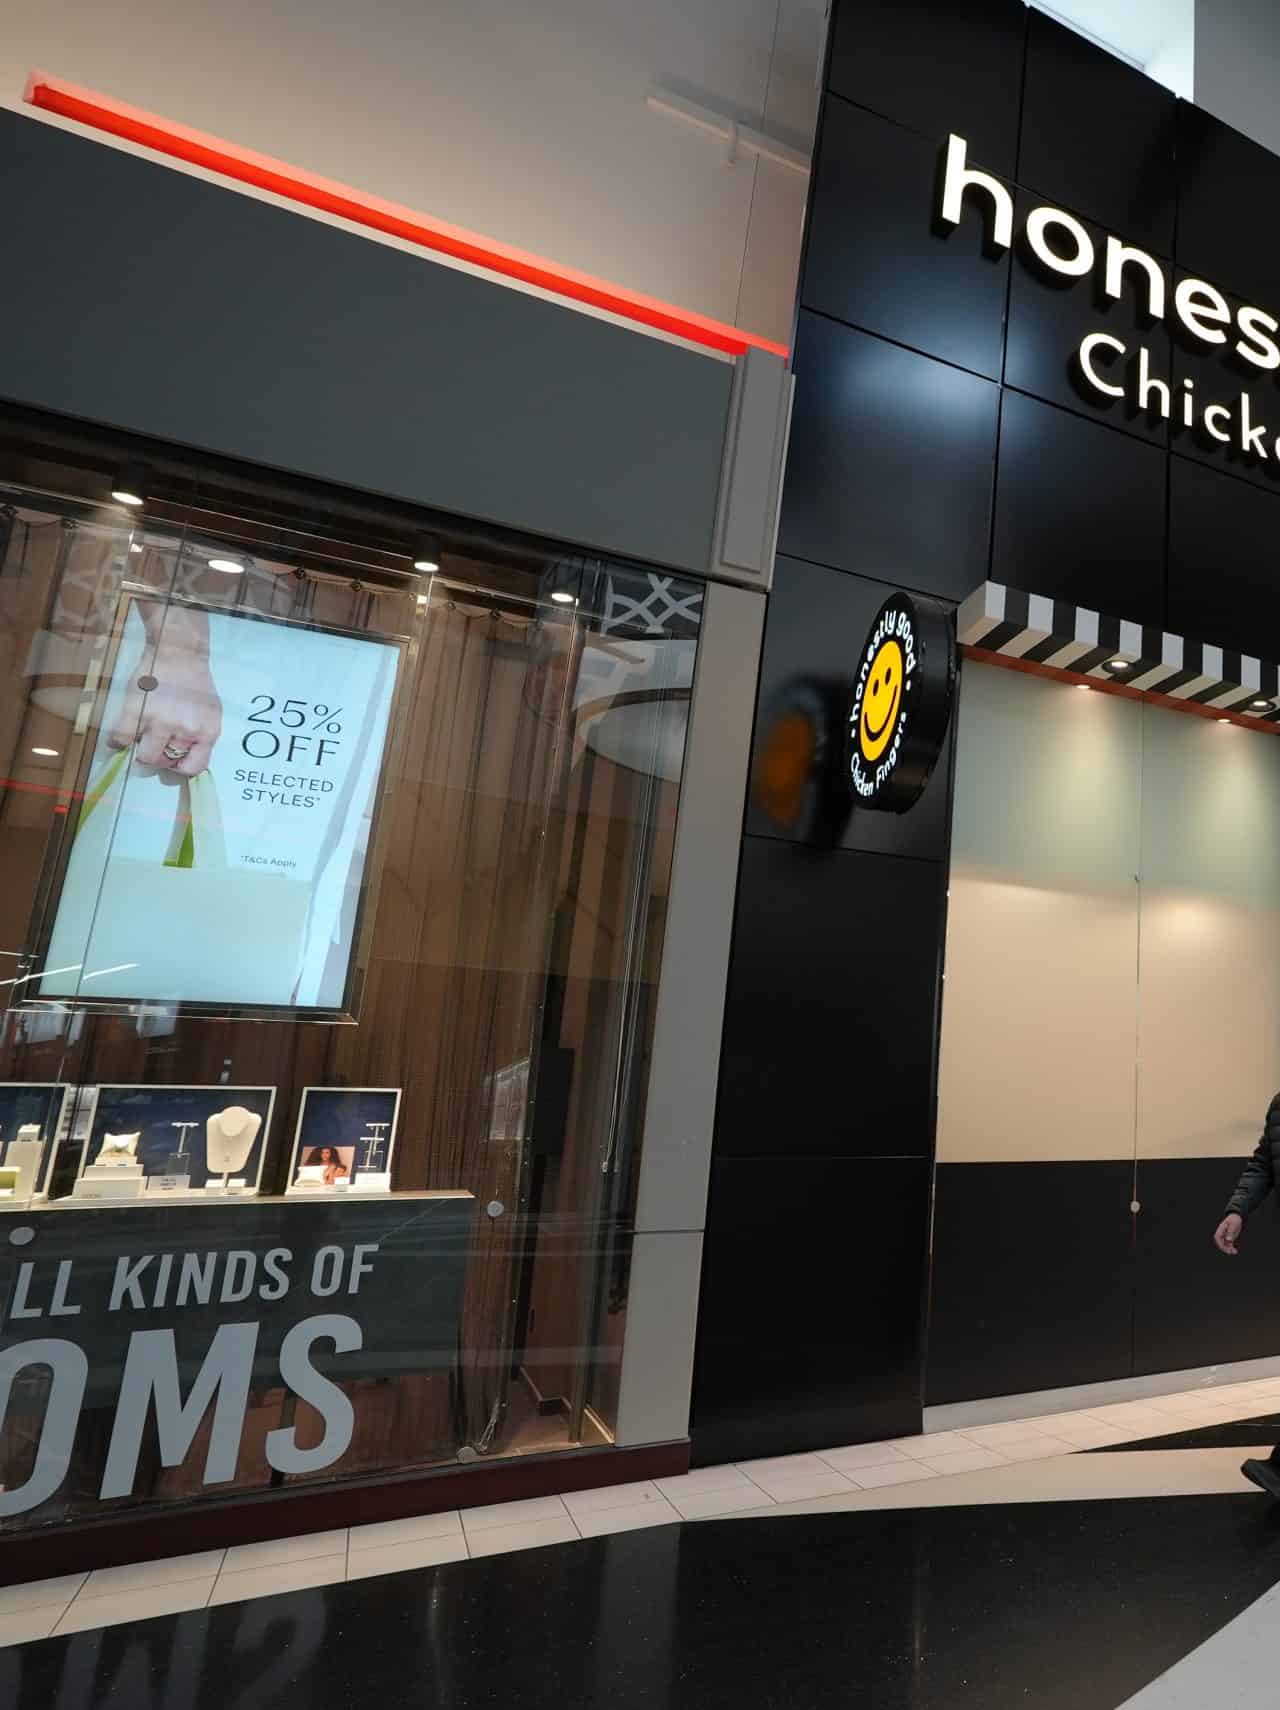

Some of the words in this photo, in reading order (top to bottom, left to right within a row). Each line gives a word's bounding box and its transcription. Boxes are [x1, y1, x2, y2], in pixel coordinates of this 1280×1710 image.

[850, 610, 897, 722] honestly
[896, 611, 916, 674] good
[247, 694, 343, 734] 25%
[241, 729, 341, 766] OFF
[851, 752, 874, 796] Chicken
[876, 711, 907, 789] Fingers
[233, 768, 334, 793] SELECTED
[270, 857, 296, 869] Apply
[108, 1247, 293, 1311] KINDS
[310, 1243, 379, 1296] OF
